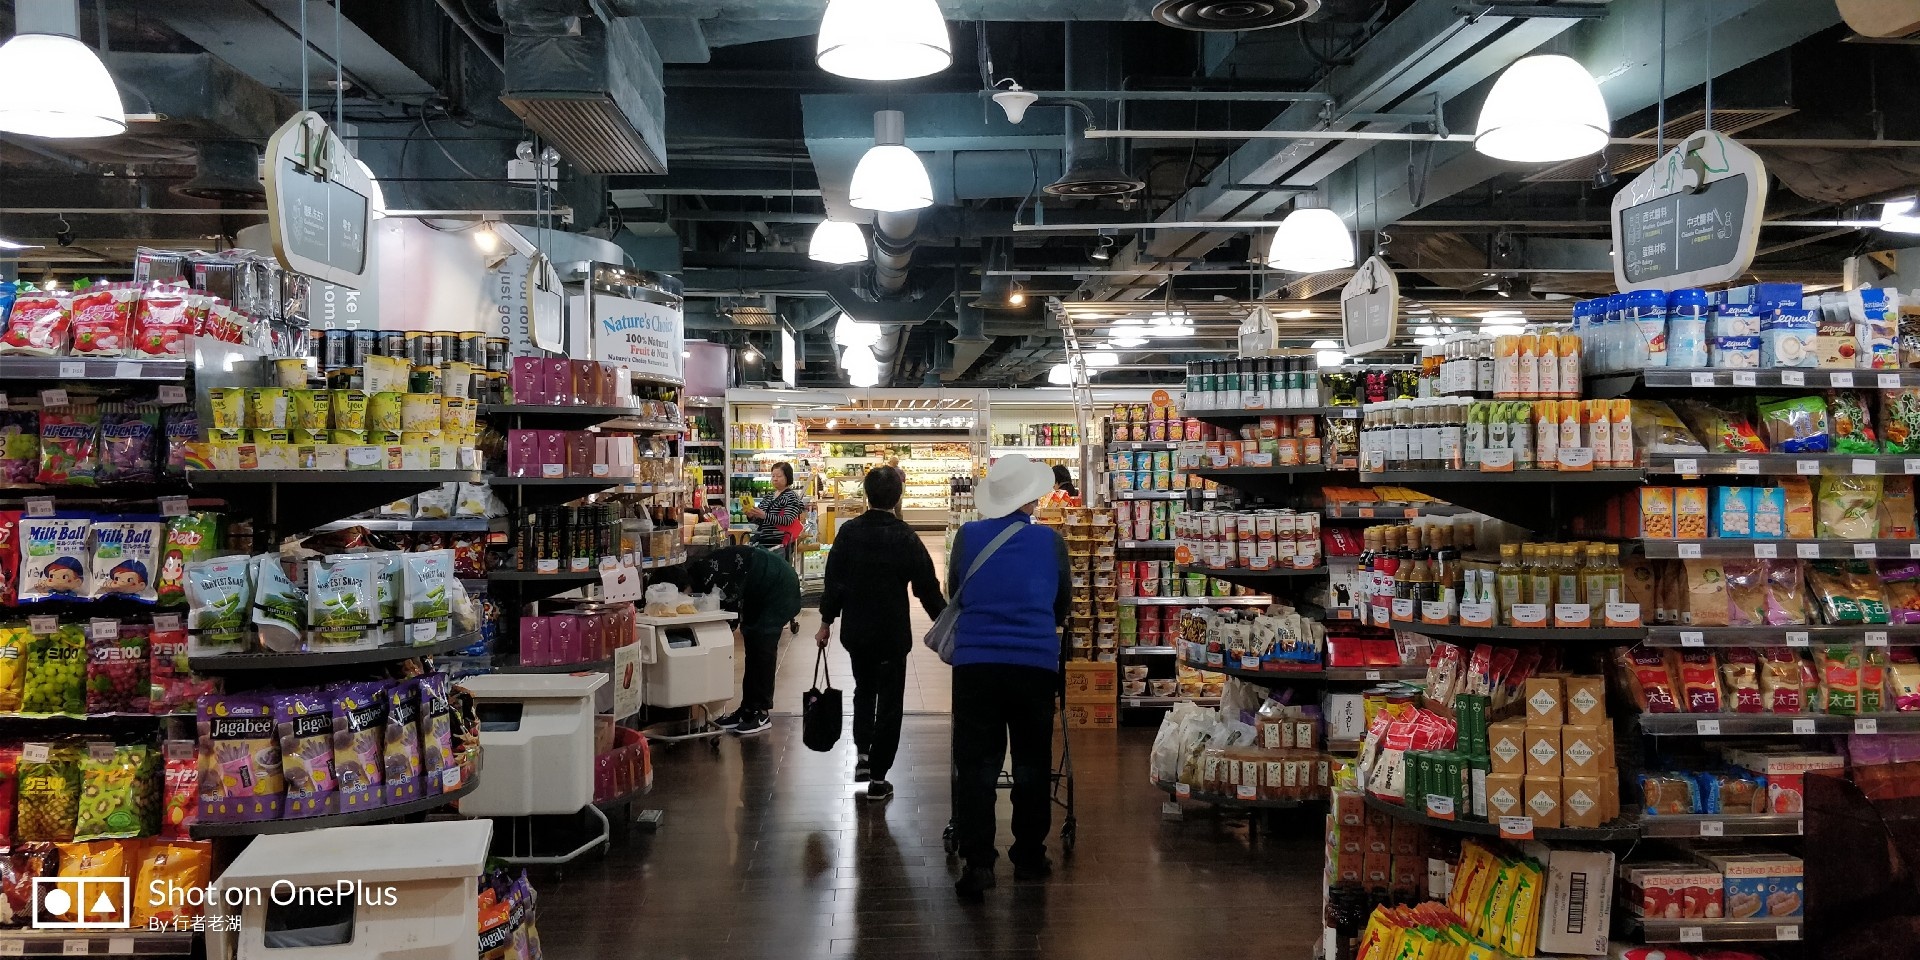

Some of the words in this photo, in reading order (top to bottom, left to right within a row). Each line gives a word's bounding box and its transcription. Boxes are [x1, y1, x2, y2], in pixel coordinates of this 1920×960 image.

[304, 122, 332, 184] 14
[498, 267, 513, 301] just
[1726, 306, 1753, 316] equal
[602, 312, 651, 336] Nature's
[652, 316, 673, 332] Choice
[1773, 310, 1817, 328] equal
[1818, 322, 1851, 336] equal
[626, 334, 648, 345] 100%
[648, 336, 668, 348] Natural
[1723, 338, 1752, 350] equal
[630, 345, 650, 356] Fruit
[43, 423, 96, 438] HI-CHEW
[102, 423, 150, 438] HI-CHEW
[166, 424, 198, 437] HI-CHE
[29, 526, 58, 540] Milk
[59, 526, 86, 540] Ball
[97, 528, 124, 544] Milk
[124, 528, 152, 544] Ball
[169, 528, 202, 546] Peko
[378, 573, 394, 582] NAPS
[1862, 602, 1886, 614] 太古
[94, 646, 142, 659] グミ100
[1646, 692, 1672, 704] 太古
[1691, 692, 1716, 704] 太古
[1740, 692, 1761, 705] 太古
[1775, 693, 1799, 706] 太古
[1830, 694, 1856, 708] 太古
[232, 706, 254, 714] Calbee
[212, 720, 271, 738] Jagabee
[296, 716, 332, 736] Jagab
